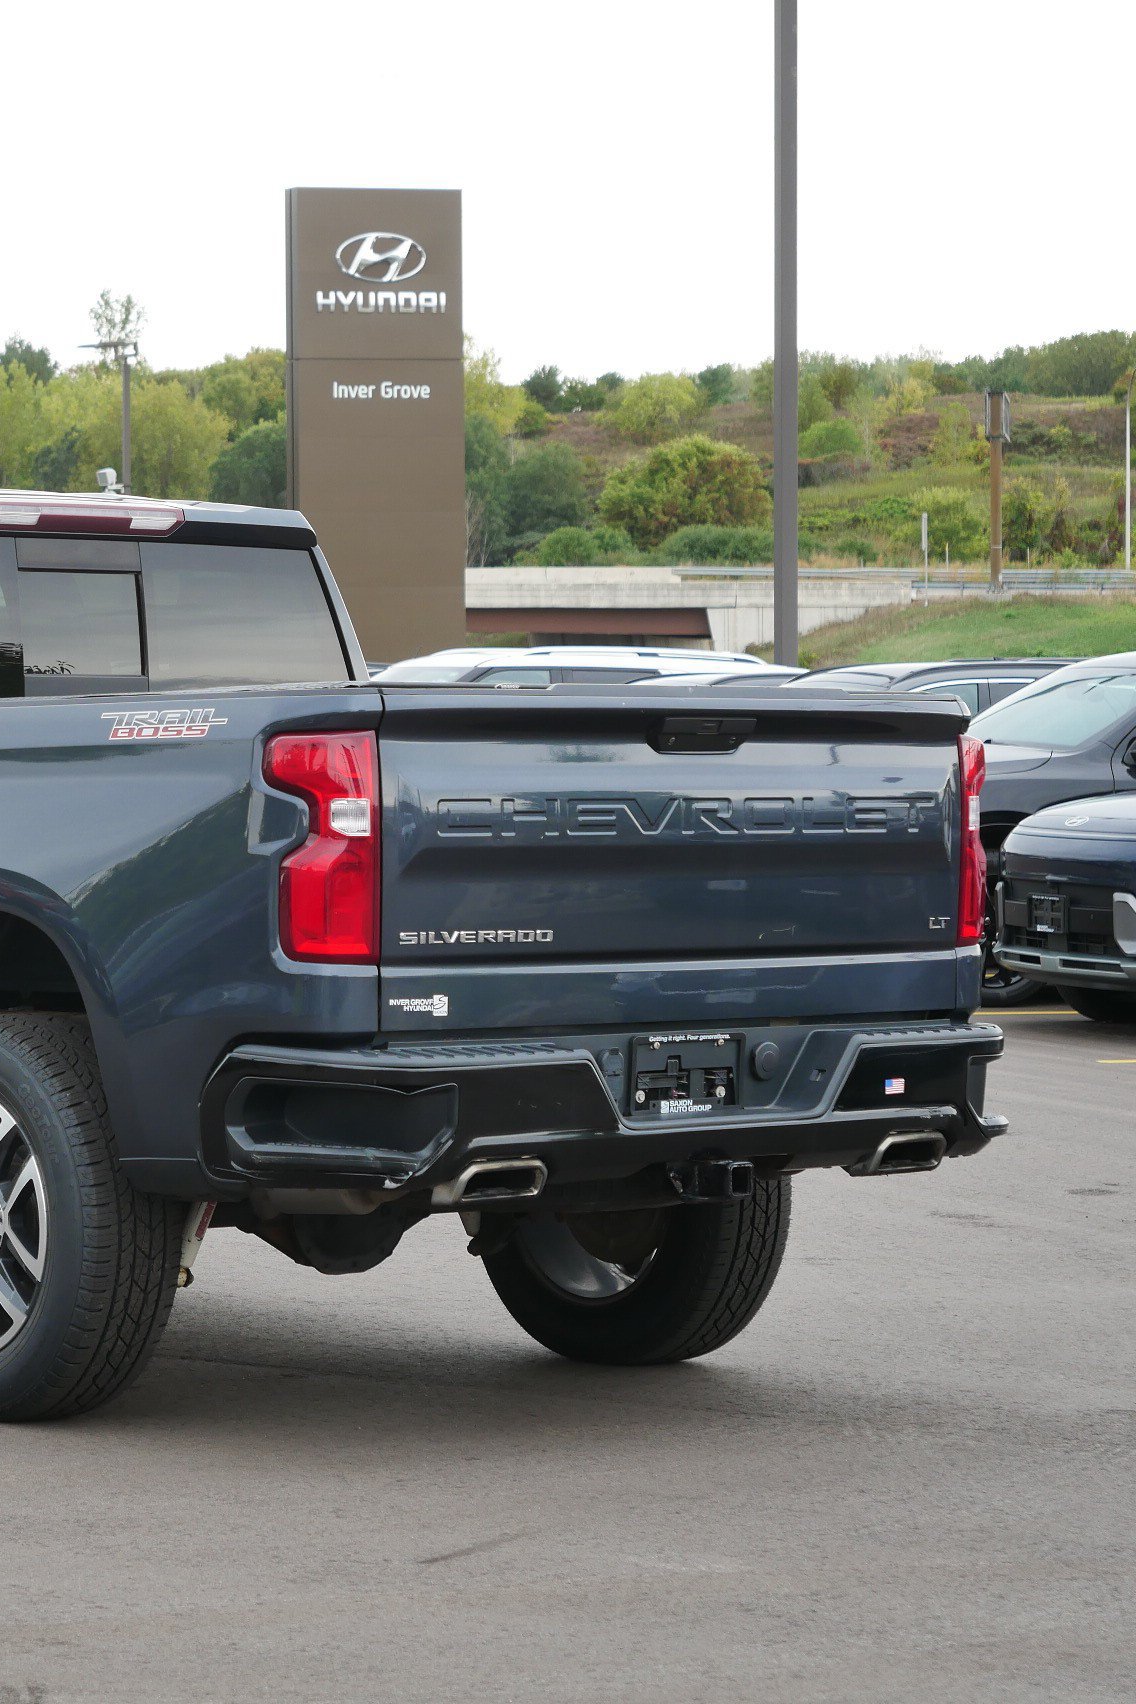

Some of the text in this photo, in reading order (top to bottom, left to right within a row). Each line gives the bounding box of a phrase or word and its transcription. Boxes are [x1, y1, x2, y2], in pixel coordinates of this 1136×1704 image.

[316, 291, 447, 314] HYUNDAI
[332, 381, 431, 399] Inver Grove
[101, 708, 229, 728] TRAIL
[108, 724, 210, 740] BOSS
[437, 797, 936, 838] CHEVROLET
[929, 917, 951, 929] LT
[399, 929, 554, 945] SILVERADO
[389, 998, 410, 1006] INVER
[670, 1099, 693, 1107] SAXON
[688, 1104, 712, 1112] GROUP
